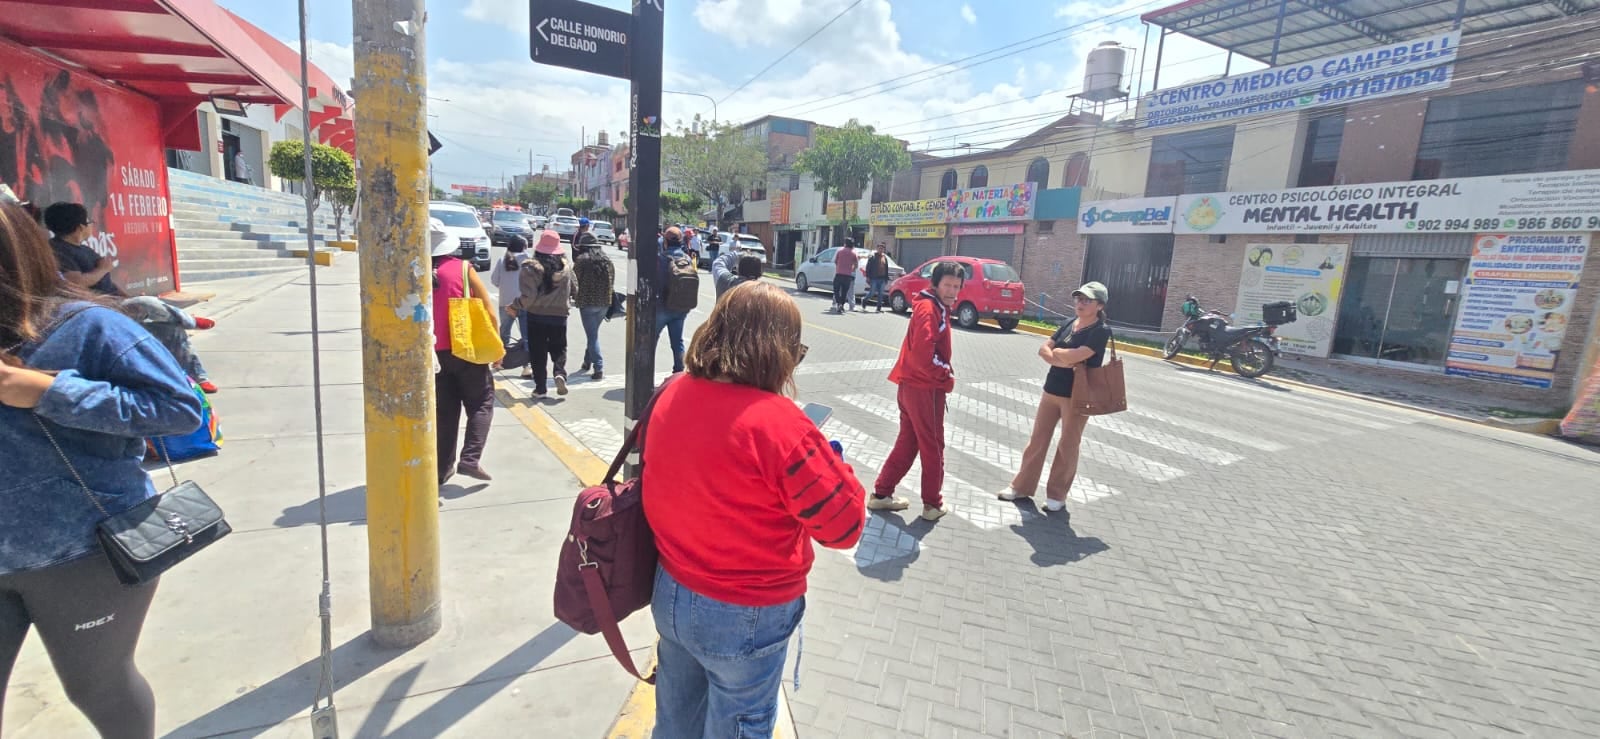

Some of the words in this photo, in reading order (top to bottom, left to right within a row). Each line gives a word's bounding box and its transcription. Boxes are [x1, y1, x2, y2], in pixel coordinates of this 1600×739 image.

[550, 17, 582, 35] CALLE
[584, 24, 627, 45] HONORIO
[550, 33, 597, 53] DELGADO
[1159, 82, 1226, 106] CENTRO
[1232, 64, 1314, 94] MEDICO
[1322, 37, 1453, 78] CAMPBELL
[1222, 100, 1296, 117] INTERNA
[121, 161, 155, 188] SÁBADO
[1229, 193, 1277, 206] CENTRO
[1281, 186, 1374, 204] PSICOLÓGICO
[1378, 182, 1461, 200] INTEGRAL
[110, 192, 125, 216] 14
[128, 194, 168, 216] FEBRERO
[892, 201, 920, 213] CONTABLE
[1243, 203, 1322, 223] MENTAL
[1327, 201, 1418, 222] HEALTH
[1101, 206, 1171, 226] CampBell
[1417, 219, 1441, 231] 902
[1444, 218, 1471, 230] 994
[1474, 217, 1500, 230] 989
[1518, 217, 1547, 230] 986
[1551, 216, 1582, 229] 860
[1587, 216, 1600, 228] 9
[1343, 222, 1378, 230] Adultos
[1508, 236, 1566, 244] PROGRAMA
[1567, 235, 1582, 244] DE
[1500, 244, 1586, 254] ENTRENAMIENTO
[1472, 261, 1523, 270] HABILIDADES
[75, 613, 115, 631] HDEX
